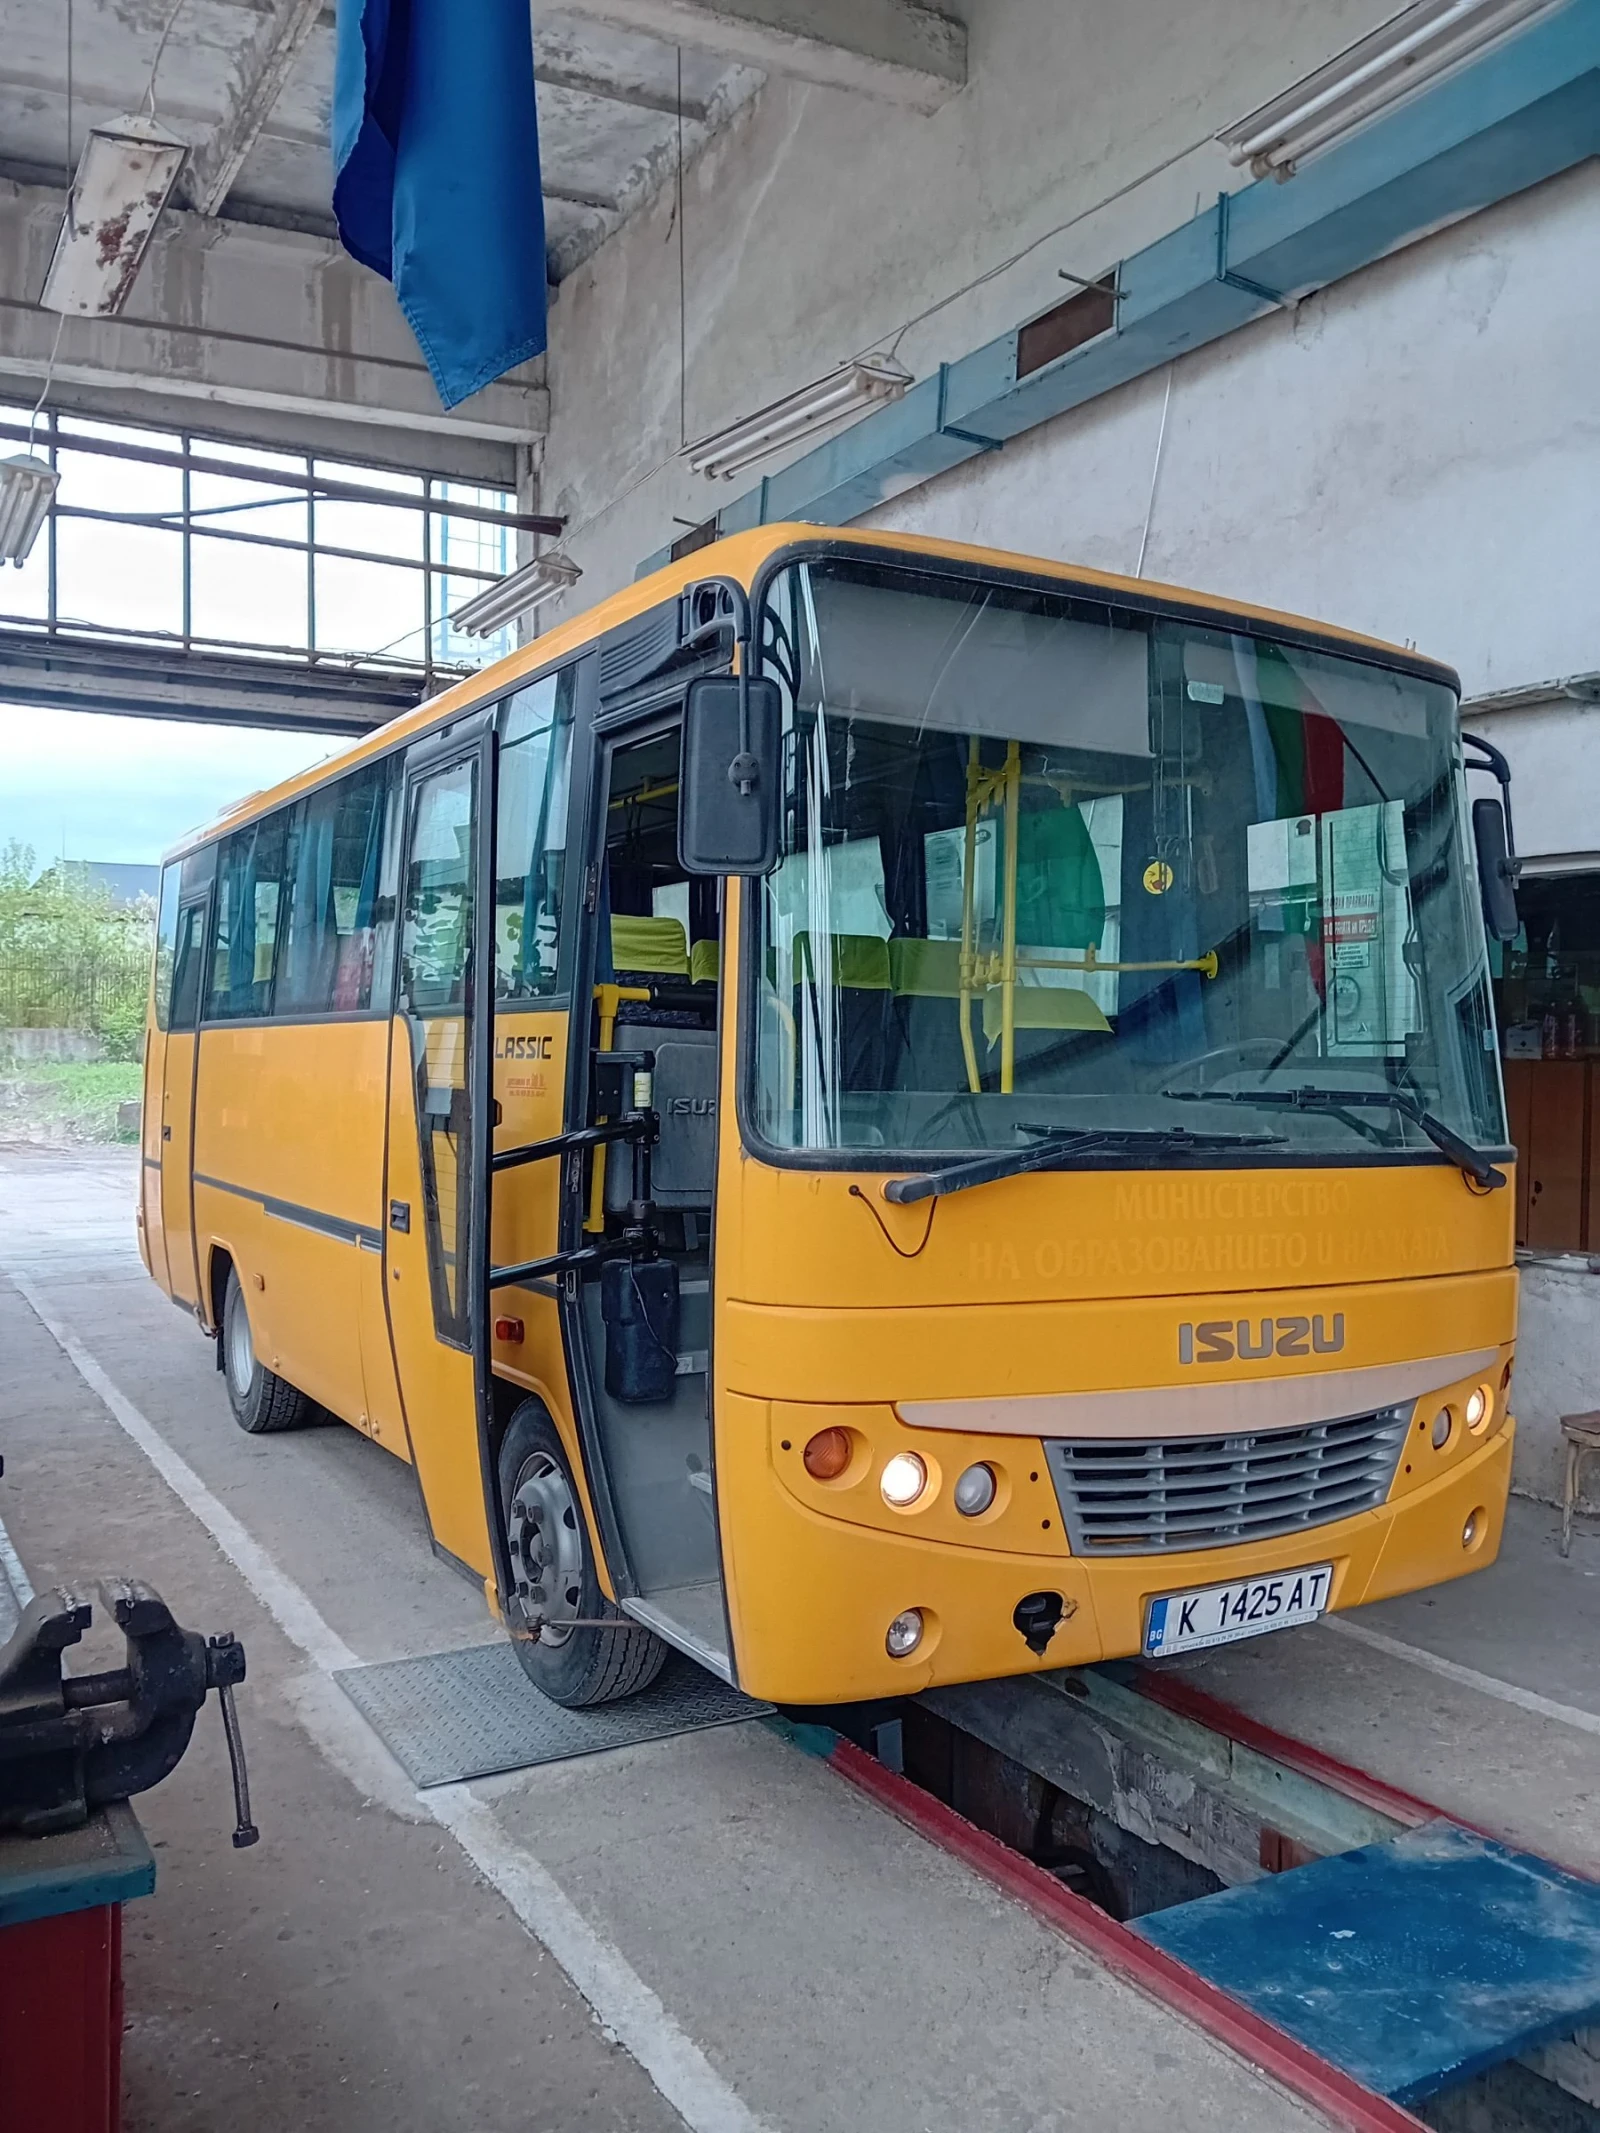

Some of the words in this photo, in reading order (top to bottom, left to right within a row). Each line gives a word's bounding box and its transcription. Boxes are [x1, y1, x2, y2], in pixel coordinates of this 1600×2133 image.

[1113, 1180, 1351, 1222] МИНИСТЕРСТВО
[968, 1241, 1021, 1281] НА
[1179, 1313, 1344, 1364] ISUZU
[1150, 1629, 1163, 1642] BG
